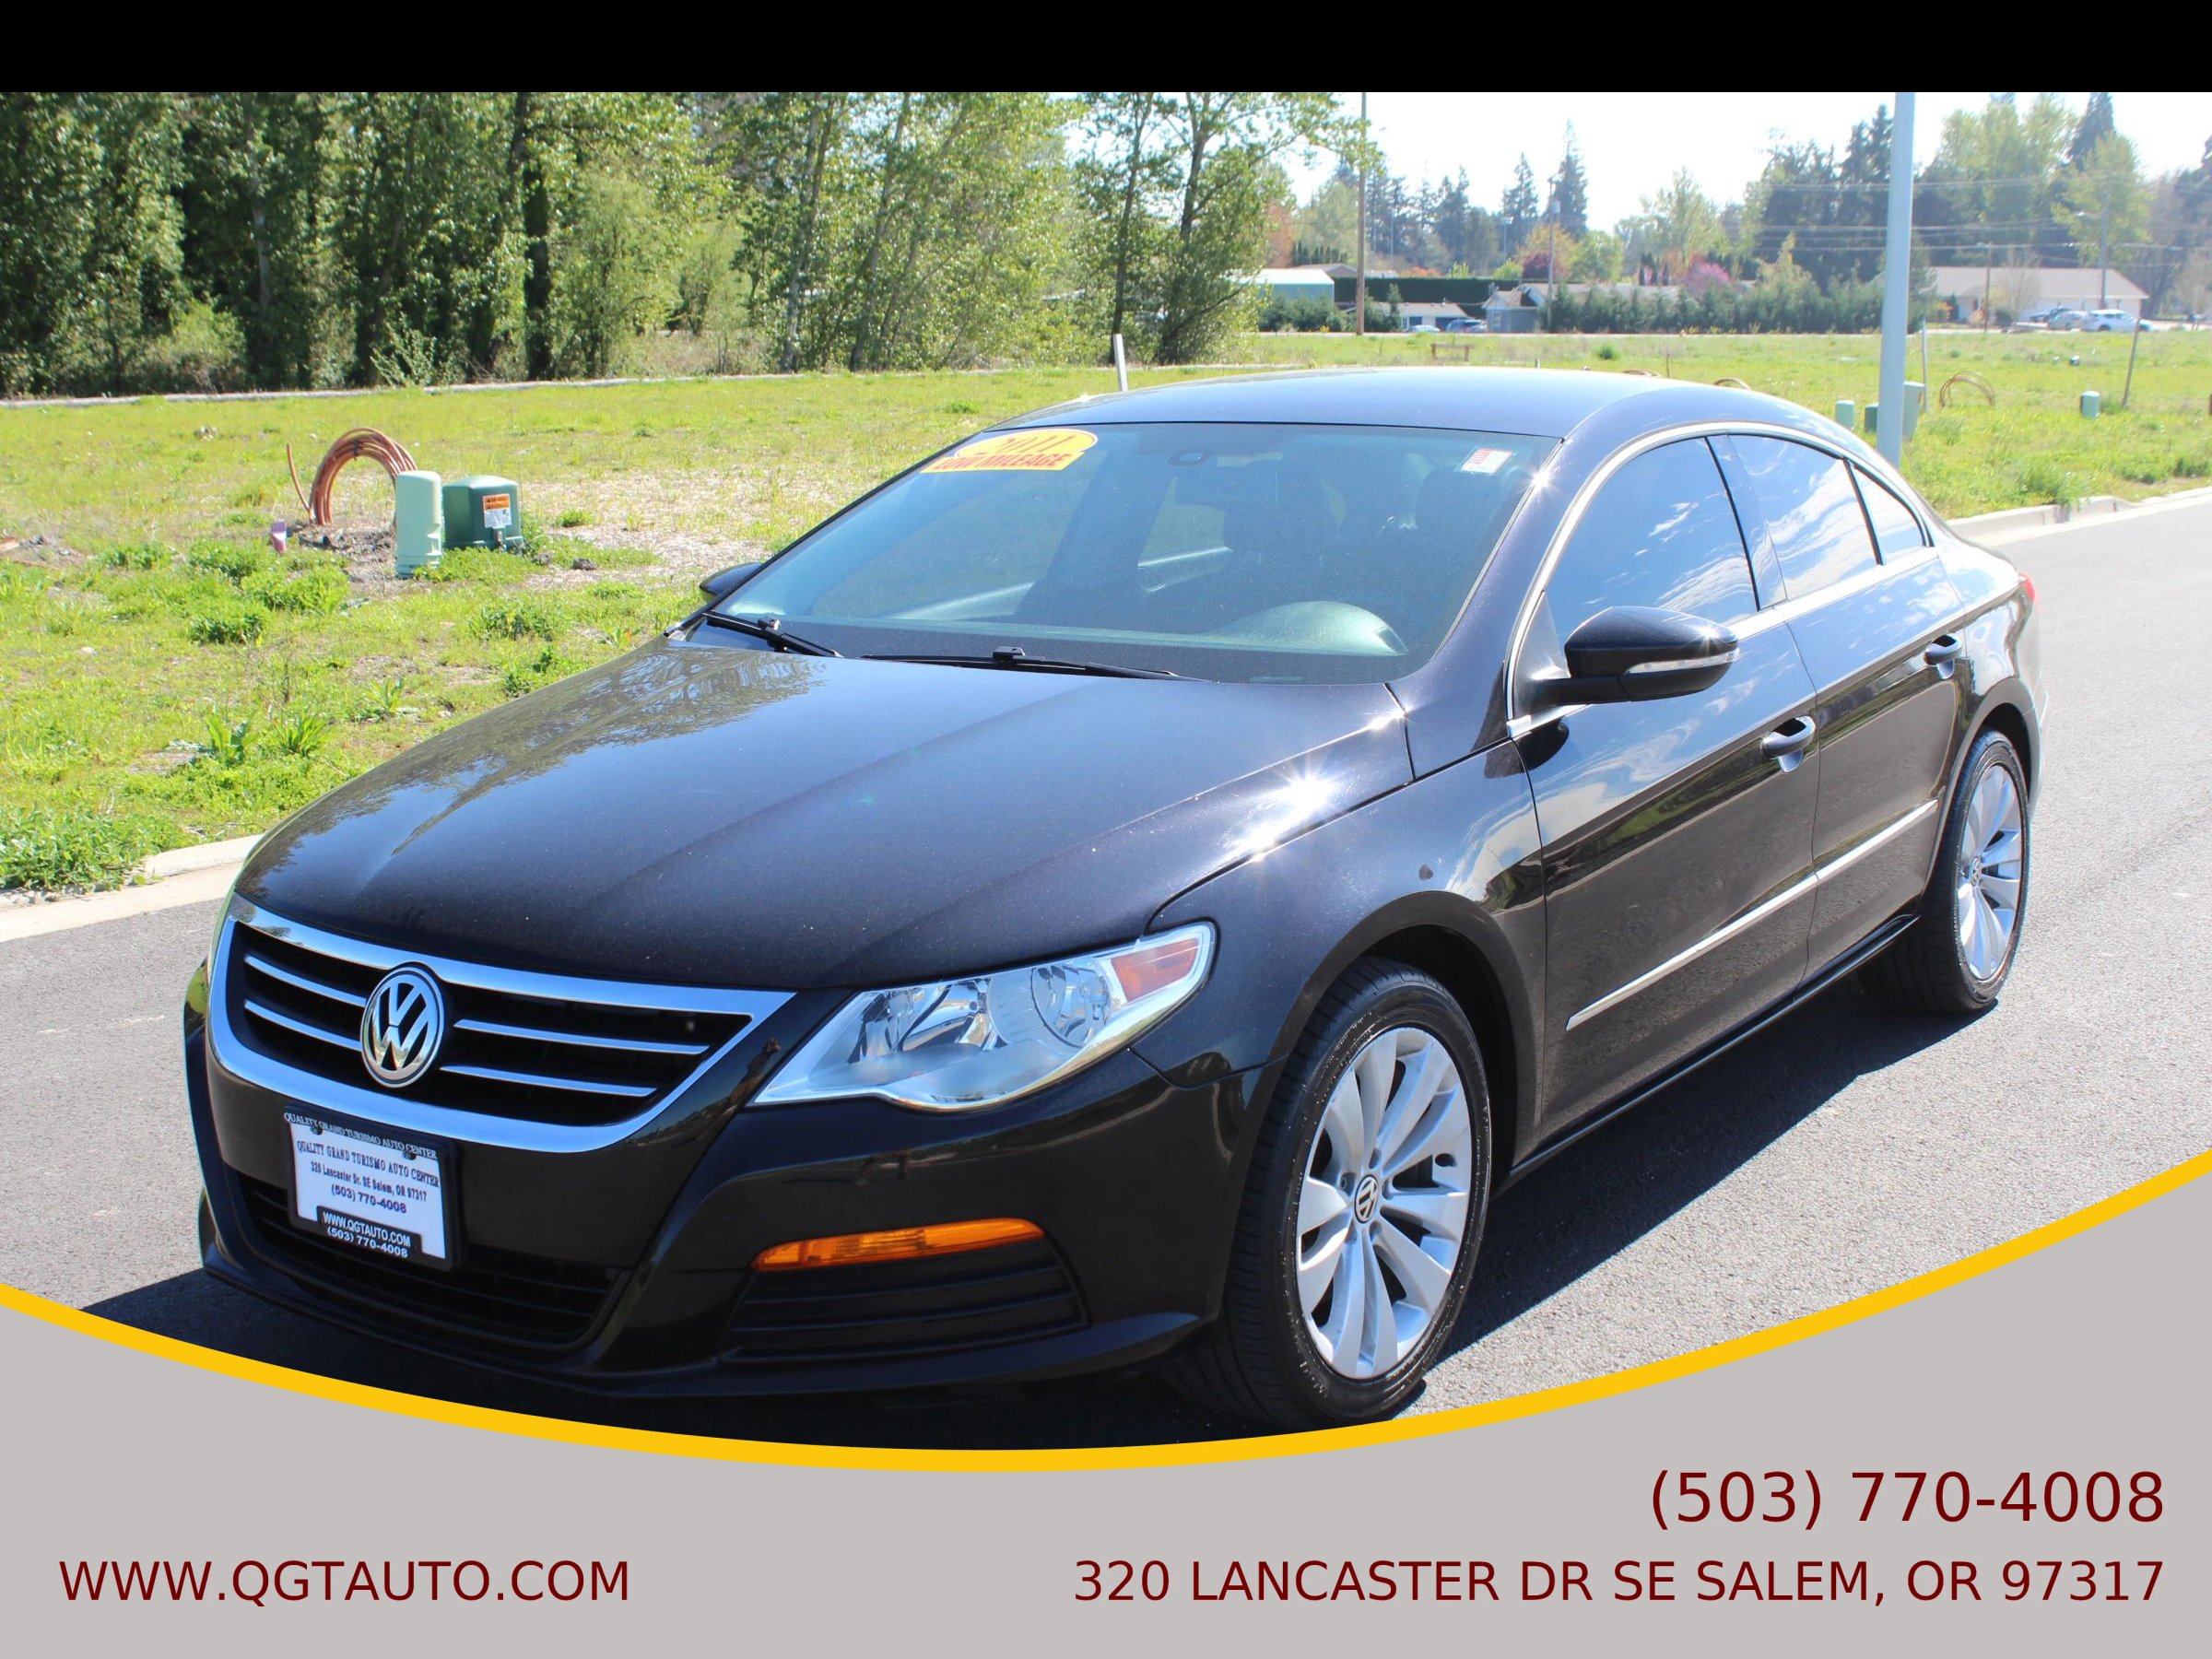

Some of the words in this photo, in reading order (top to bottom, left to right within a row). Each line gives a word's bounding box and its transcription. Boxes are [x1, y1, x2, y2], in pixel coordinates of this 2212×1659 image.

[284, 1112, 319, 1127] QUALITY
[320, 1121, 346, 1137] GRAND
[346, 1128, 382, 1147] TURISMO
[382, 1138, 406, 1151] AUTO
[406, 1144, 439, 1160] CENTER
[297, 1140, 324, 1155] QUALITY
[326, 1146, 350, 1162] GRAND
[351, 1152, 386, 1171] TURISMO
[388, 1162, 409, 1178] AUTO
[411, 1168, 440, 1188] CENTER
[324, 1164, 352, 1182] Lancaster
[353, 1173, 362, 1185] Dr.
[363, 1176, 371, 1188] SE
[372, 1178, 394, 1196] Salem,
[396, 1184, 406, 1198] OR
[331, 1183, 356, 1203] (503)
[358, 1192, 407, 1214] 770-4008
[323, 1212, 411, 1248] WWW.QGTAUTO.COM
[327, 1227, 355, 1243] (503)
[357, 1235, 408, 1258] 770-4008
